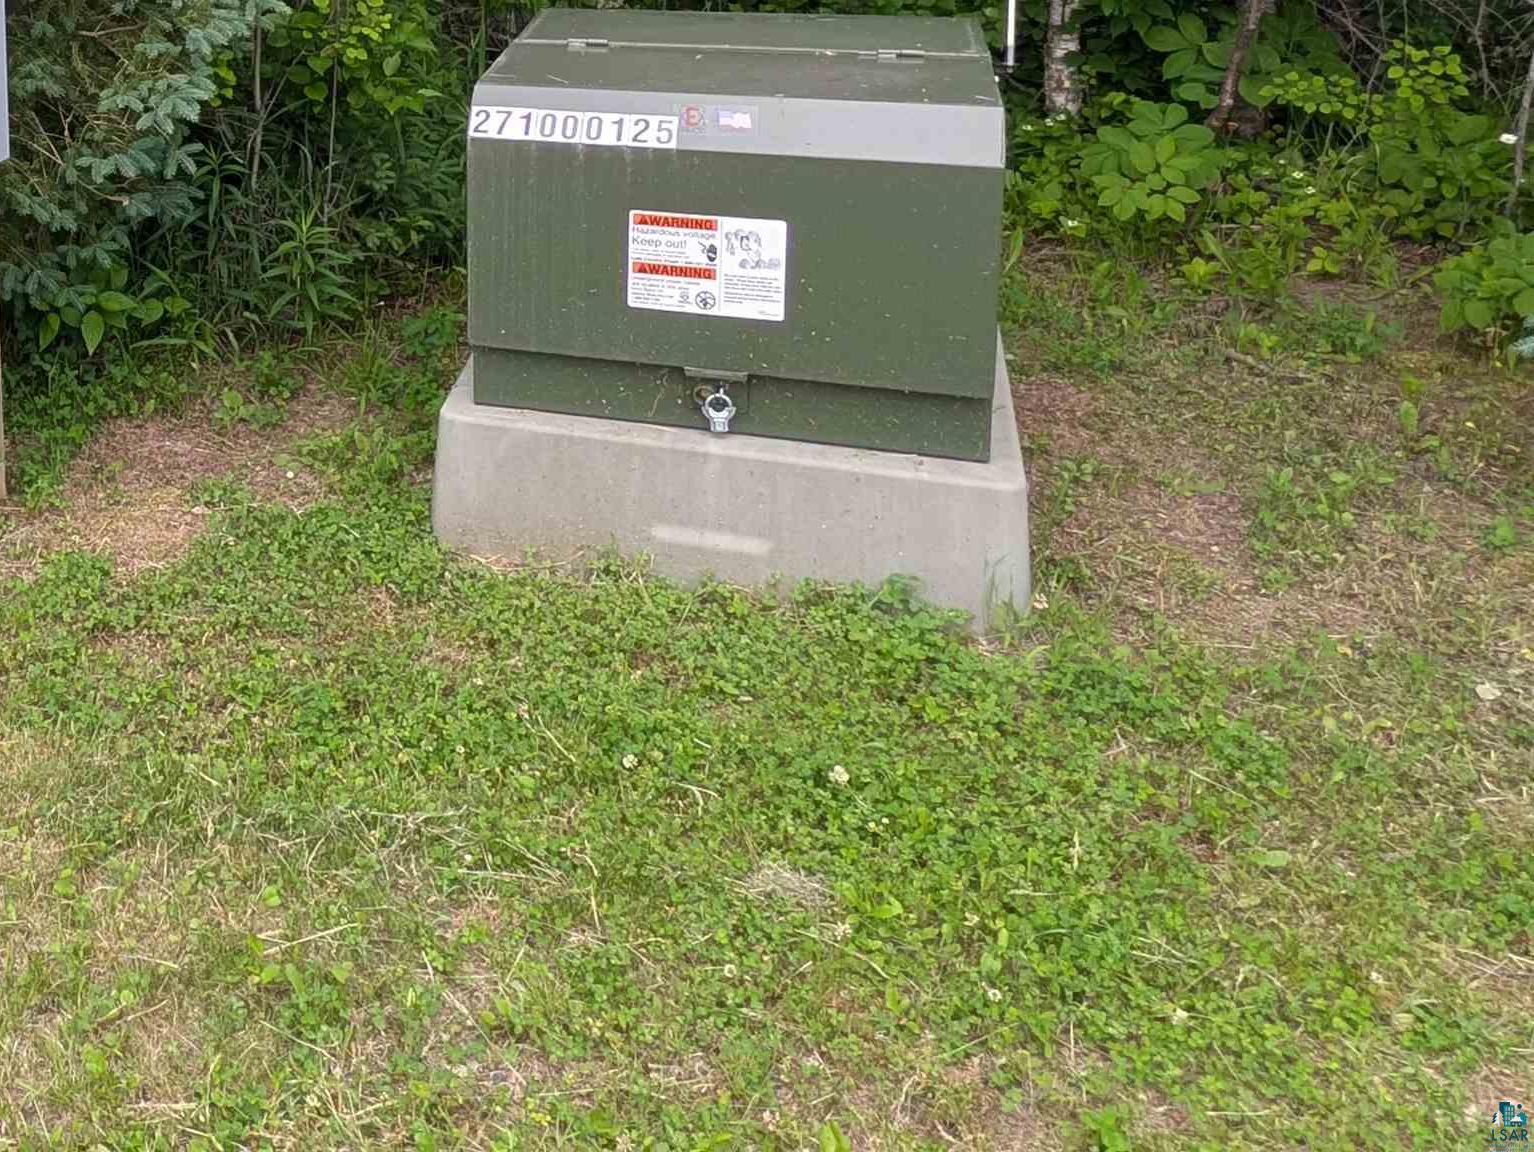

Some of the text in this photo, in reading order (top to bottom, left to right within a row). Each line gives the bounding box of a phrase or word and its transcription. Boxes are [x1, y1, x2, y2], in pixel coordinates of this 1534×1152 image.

[472, 109, 674, 145] 271000125
[648, 214, 715, 231] WARNING
[632, 235, 687, 249] Keep out!
[648, 263, 713, 280] WARNING
